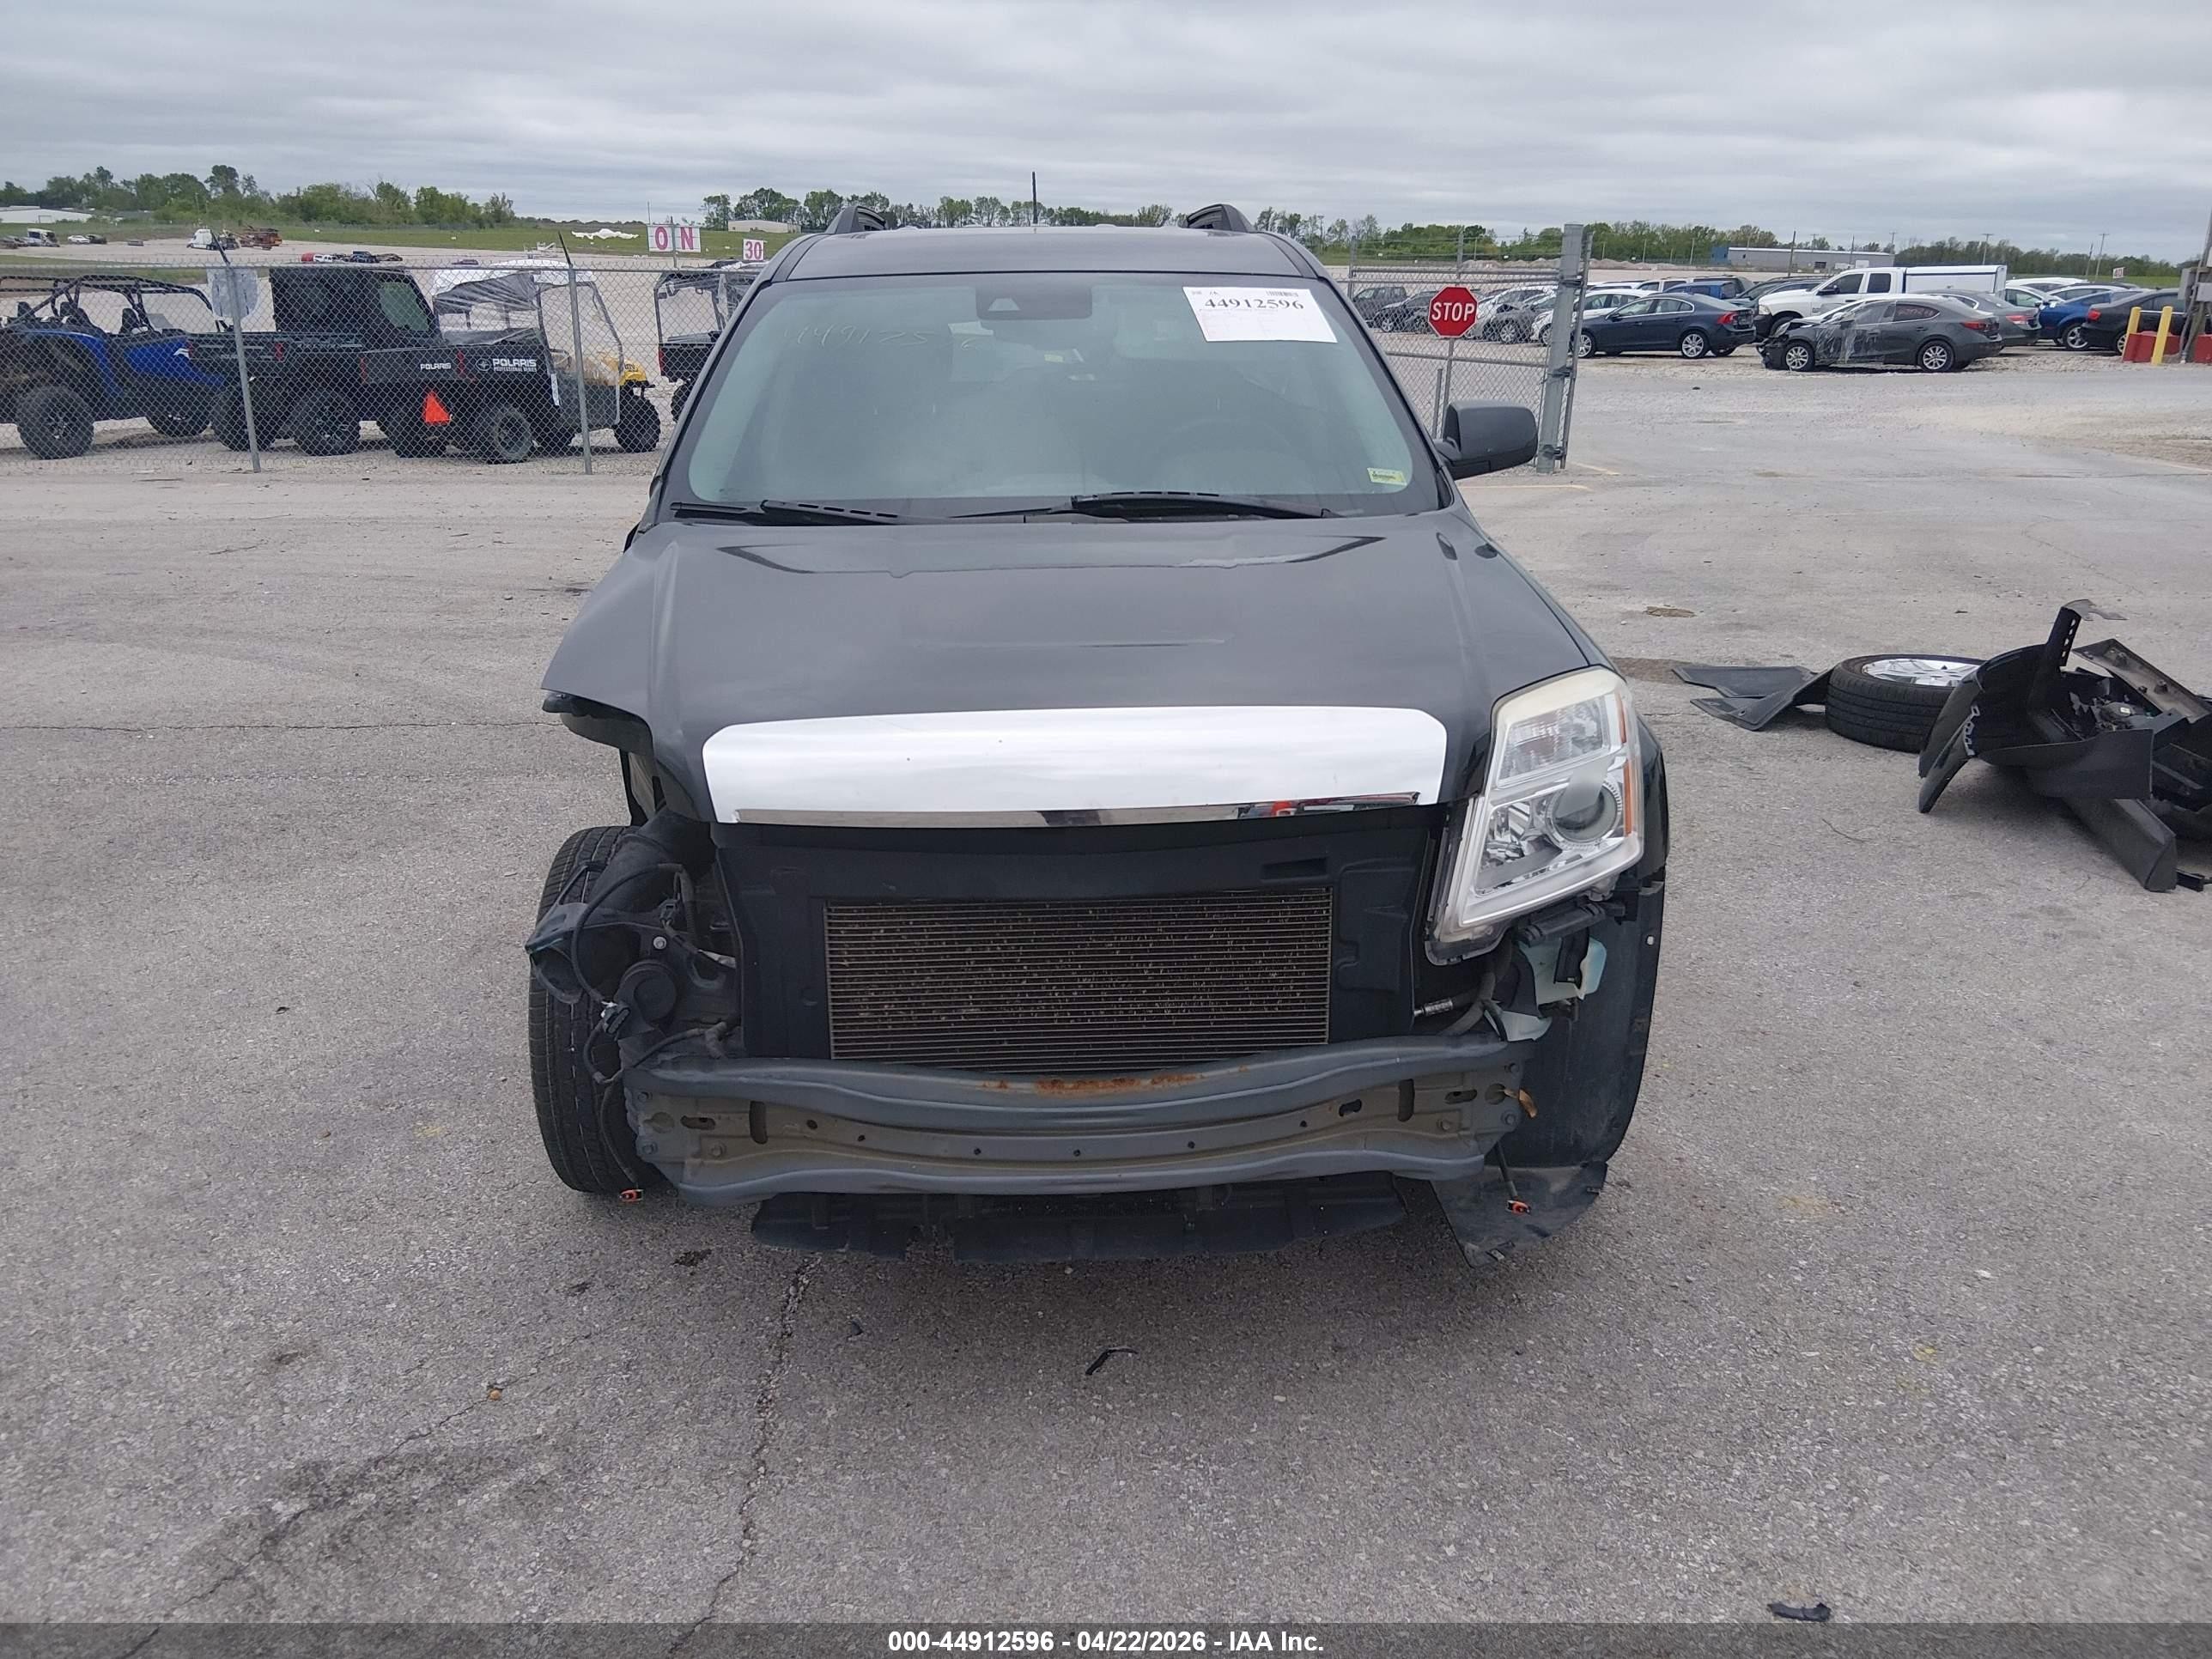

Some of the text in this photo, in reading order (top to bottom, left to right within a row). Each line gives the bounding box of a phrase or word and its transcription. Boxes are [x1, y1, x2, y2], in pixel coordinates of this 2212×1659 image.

[745, 240, 759, 259] 30
[1205, 299, 1304, 309] 44912596
[1431, 301, 1475, 321] STOP
[492, 358, 537, 367] POLARIS
